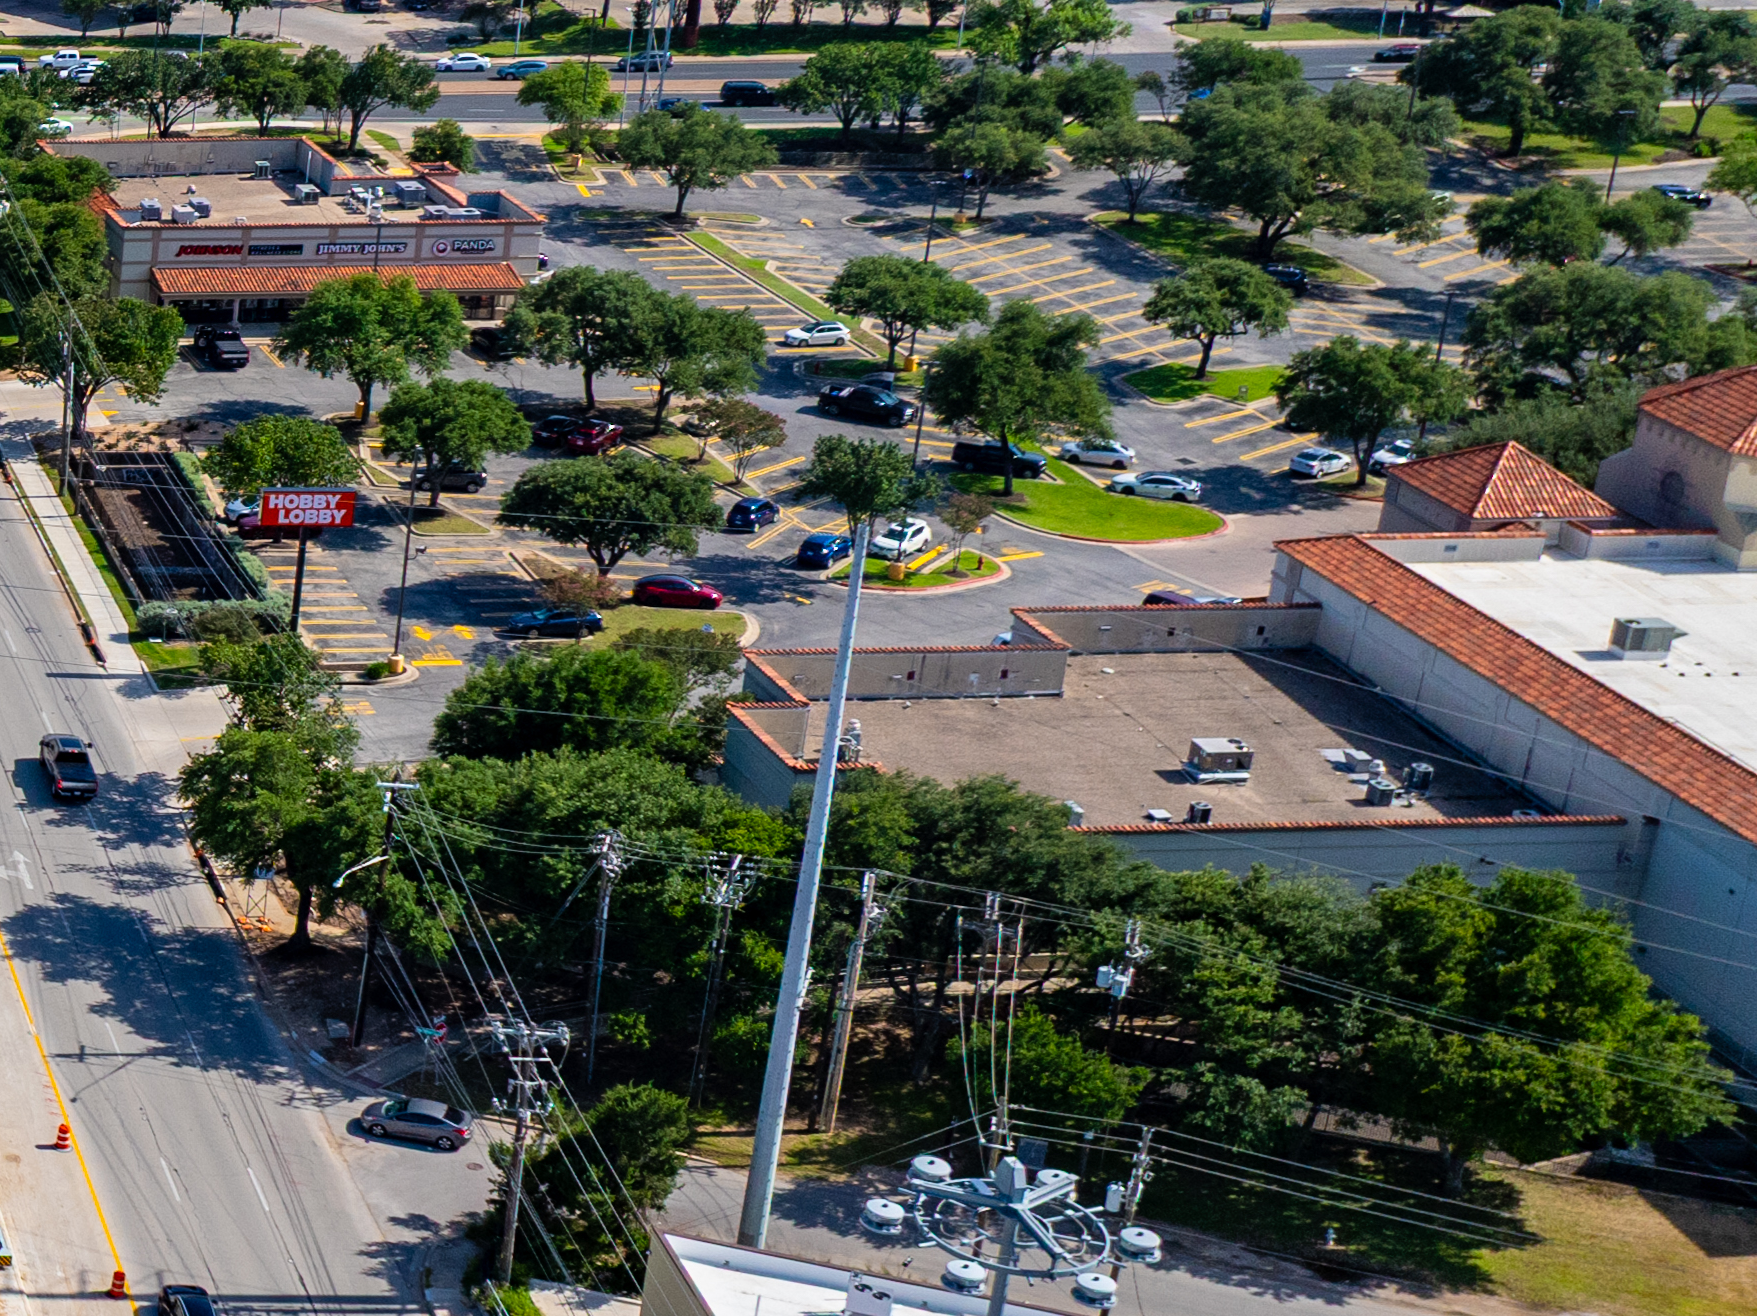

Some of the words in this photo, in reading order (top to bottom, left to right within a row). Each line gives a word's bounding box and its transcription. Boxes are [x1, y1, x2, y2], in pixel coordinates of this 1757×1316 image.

[175, 245, 244, 257] JOHNSON
[318, 244, 360, 254] JIMMY
[363, 243, 406, 254] JOHN'S
[454, 240, 495, 250] PANDA
[268, 494, 342, 509] HOBBY
[278, 509, 347, 524] LOBBY
